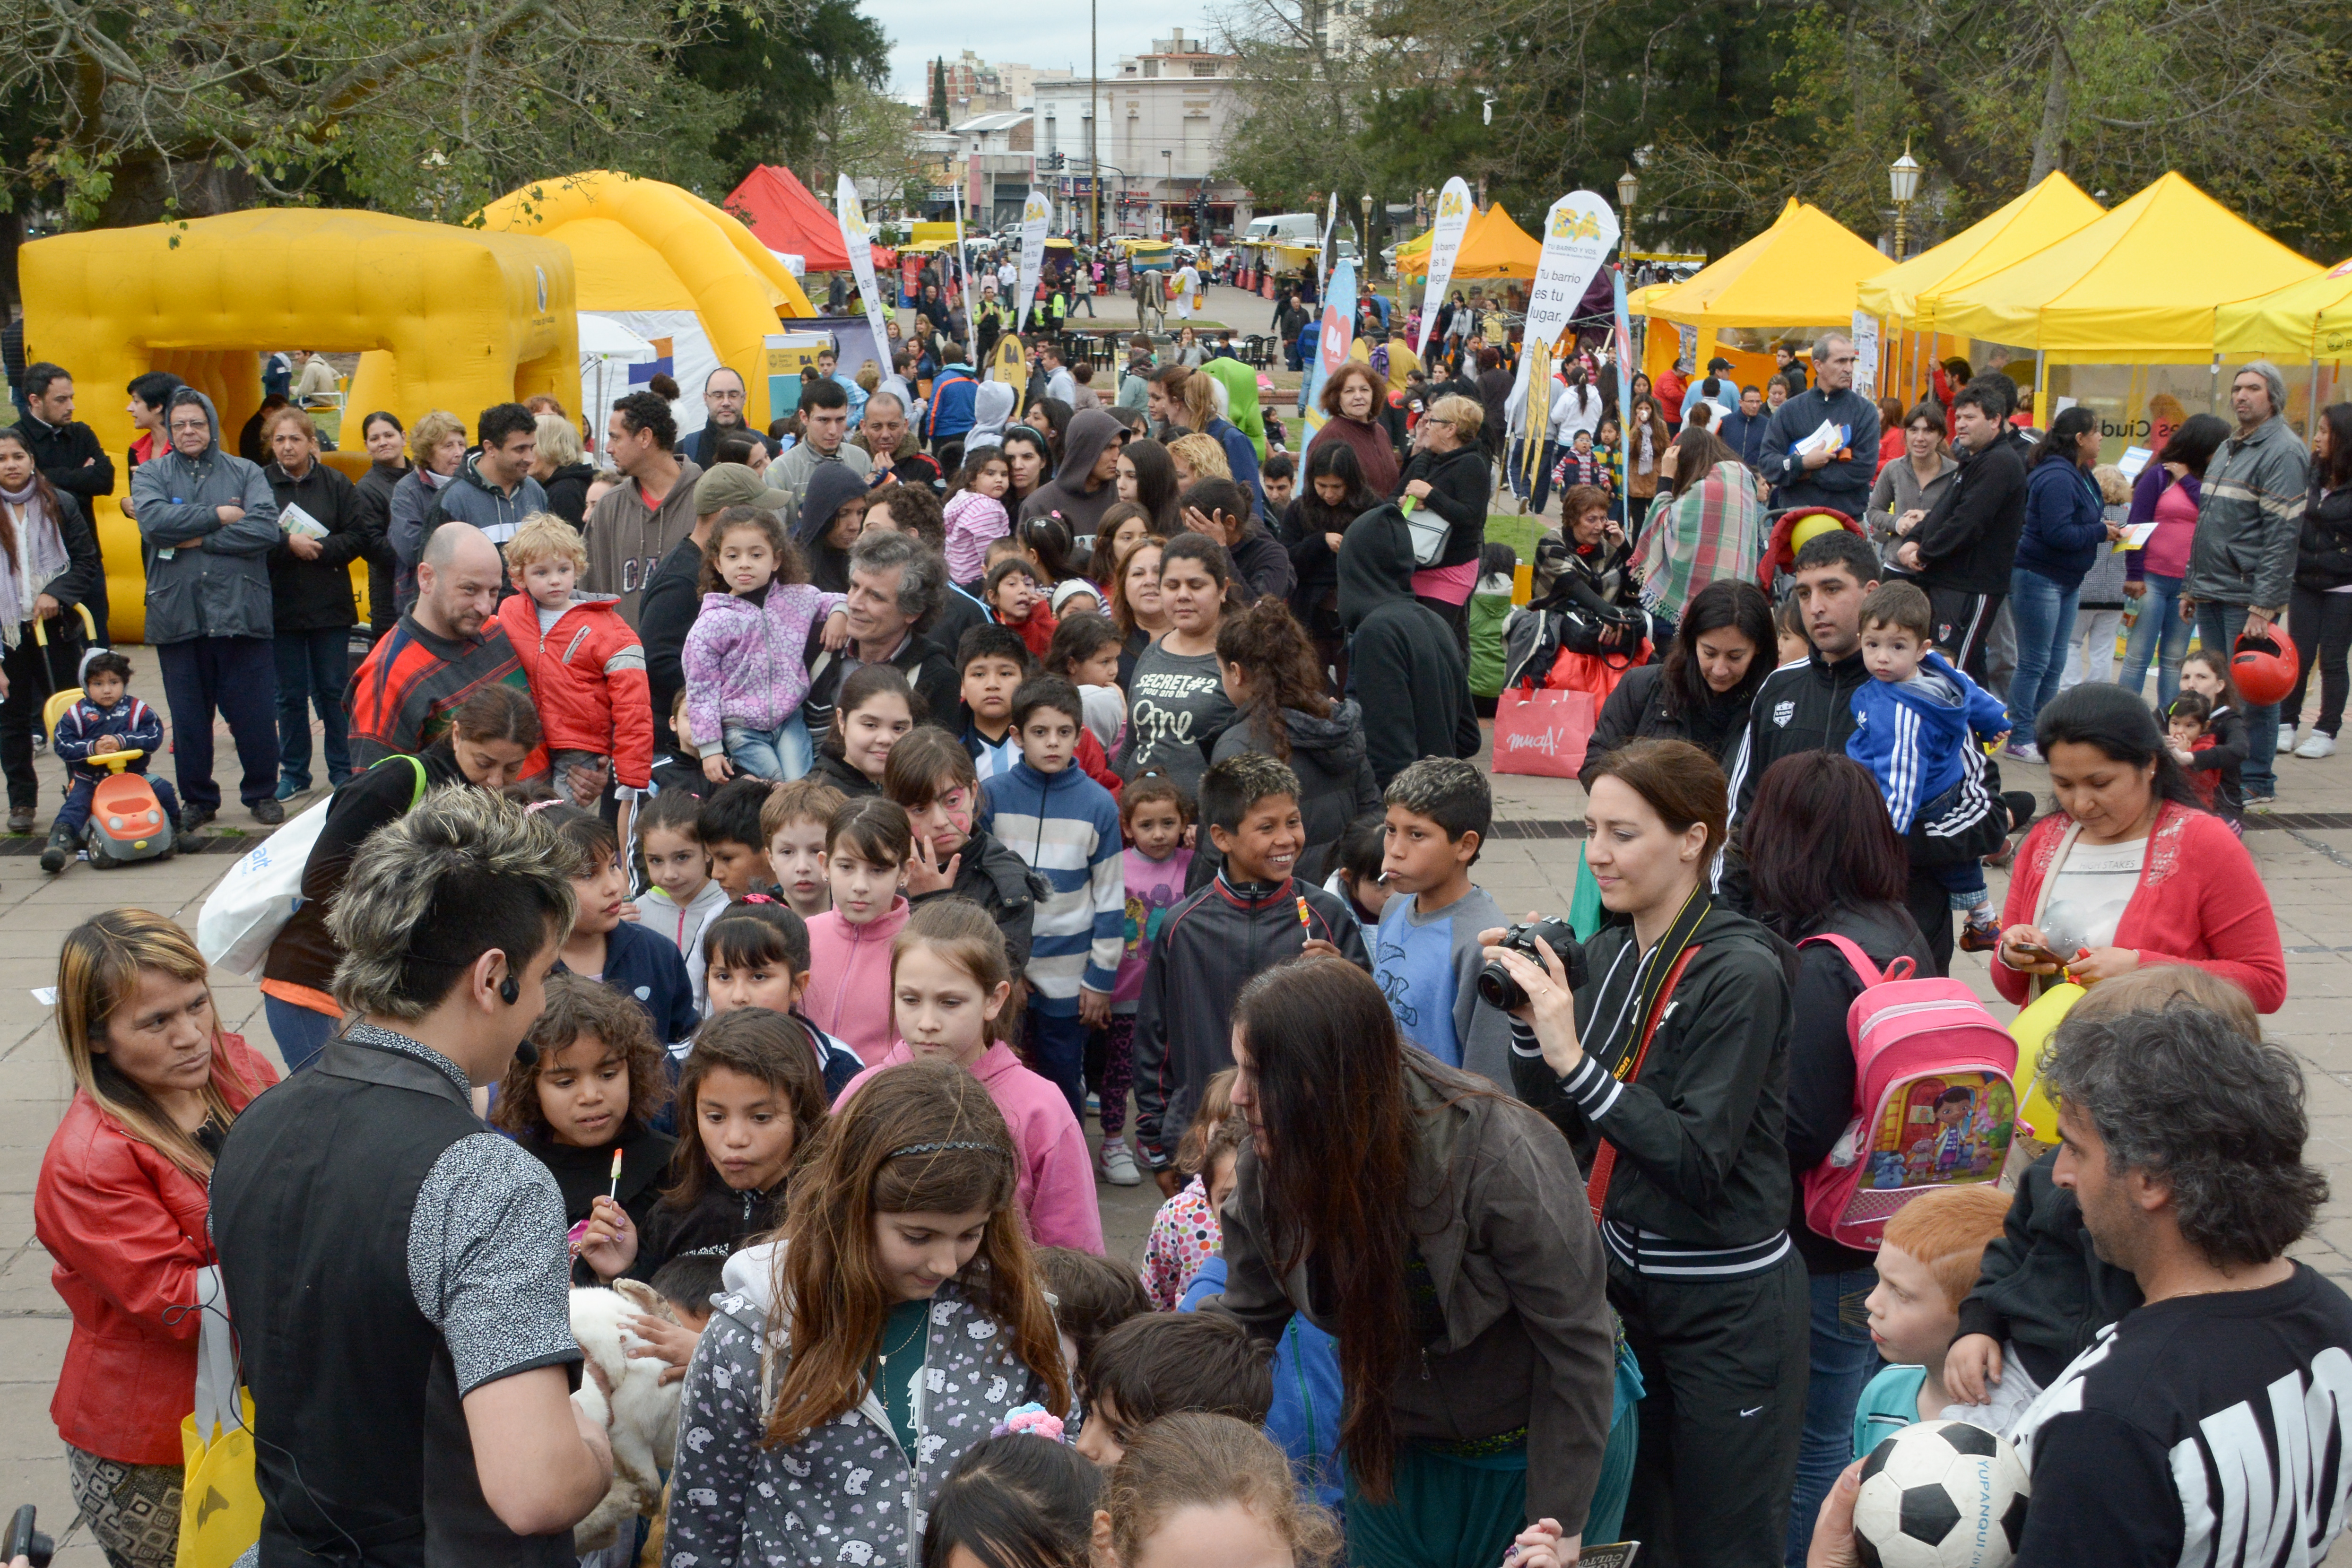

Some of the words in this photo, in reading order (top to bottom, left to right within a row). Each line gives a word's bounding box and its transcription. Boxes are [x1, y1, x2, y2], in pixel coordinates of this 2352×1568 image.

[1540, 269, 1549, 279] Tu
[1552, 270, 1580, 284] barrio
[1535, 289, 1547, 299] es
[1552, 289, 1563, 302] tu
[1529, 306, 1562, 322] lugar.
[623, 557, 659, 594] GA
[1141, 687, 1159, 695] you
[1159, 689, 1175, 697] are
[1175, 689, 1189, 698] the
[252, 847, 272, 871] art
[2079, 861, 2100, 869] HIGH
[2102, 860, 2135, 869] STAKES
[1613, 1056, 1630, 1080] kon
[1975, 1460, 1990, 1548] YUPANQUI
